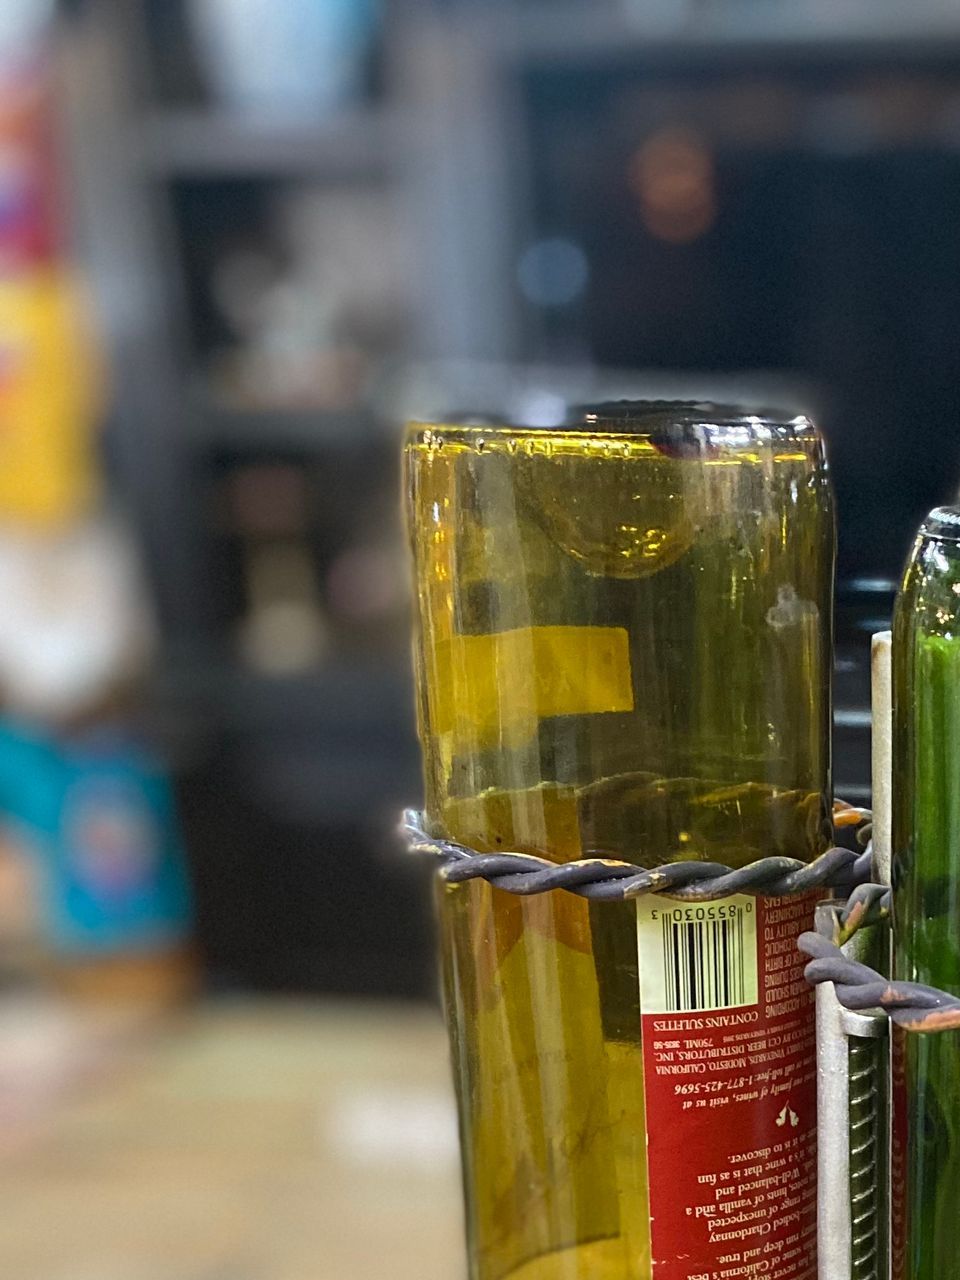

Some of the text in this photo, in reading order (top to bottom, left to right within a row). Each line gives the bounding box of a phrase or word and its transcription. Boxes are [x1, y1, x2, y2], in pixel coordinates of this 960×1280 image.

[651, 902, 753, 922] 0 855030 3
[764, 927, 774, 941] TO
[765, 984, 790, 1003] SHOULD
[653, 1010, 759, 1031] CONTAINS SULFITES
[683, 1037, 714, 1049] 750ML
[746, 1040, 767, 1052] BEER
[653, 1052, 674, 1062] INC.
[675, 1044, 745, 1061] DISTRIBUTORS,
[655, 1062, 706, 1075] CALIFORNIA
[707, 1056, 746, 1071] MODESTO,
[674, 1074, 753, 1095] 1-877-425-5696
[732, 1091, 758, 1102] wines,
[758, 1085, 768, 1100] of
[682, 1100, 693, 1109] at
[709, 1096, 729, 1108] visit
[773, 1144, 783, 1153] to
[727, 1147, 771, 1164] discover.
[744, 1165, 763, 1177] that
[765, 1158, 787, 1171] wine
[697, 1175, 717, 1185] fun
[720, 1172, 730, 1182] as
[733, 1171, 741, 1182] is
[738, 1167, 800, 1197] Well-balanced
[715, 1186, 735, 1200] and
[767, 1187, 787, 1200] hints
[719, 1198, 752, 1214] vanilla
[752, 1195, 765, 1208] of
[685, 1207, 692, 1216] a
[695, 1205, 716, 1218] and
[767, 1205, 778, 1219] of
[708, 1209, 767, 1231] unexpected
[708, 1222, 771, 1243] Chardonnay
[763, 1240, 784, 1253] deep
[715, 1253, 740, 1264] true.
[743, 1248, 761, 1262] and
[770, 1256, 780, 1269] of
[773, 1263, 796, 1279] never
